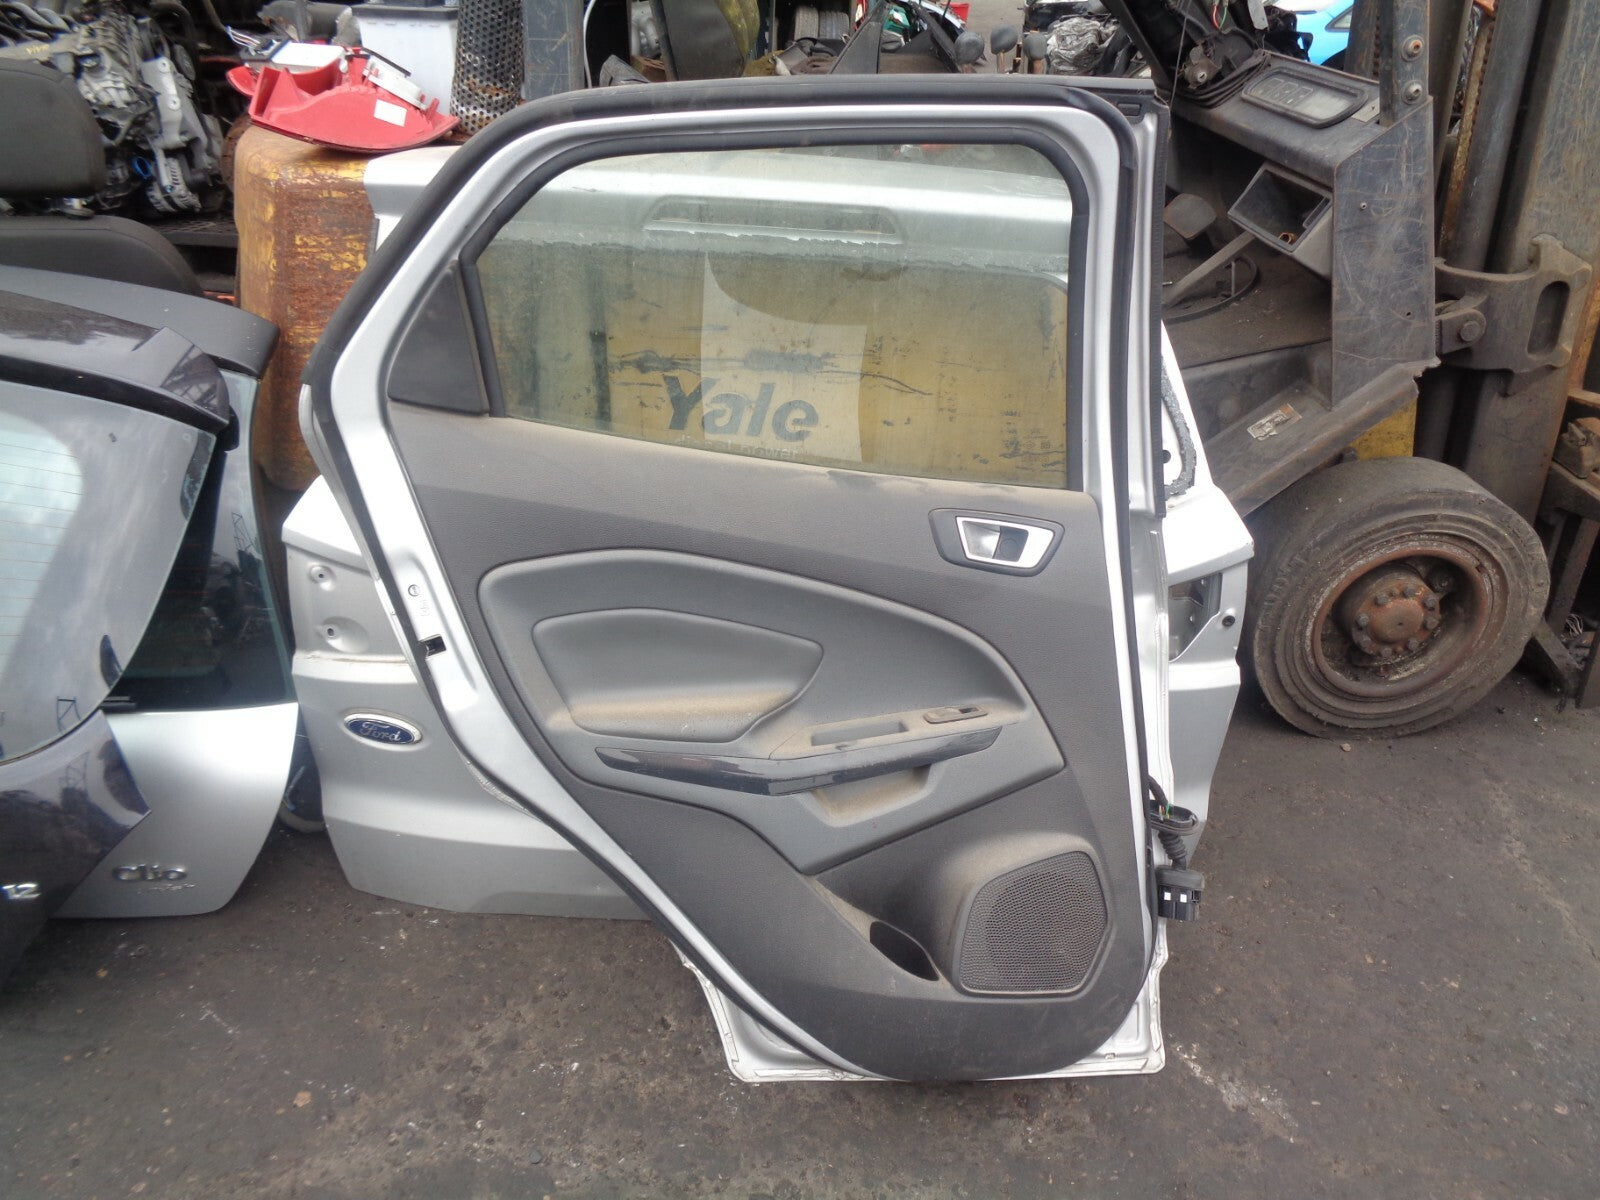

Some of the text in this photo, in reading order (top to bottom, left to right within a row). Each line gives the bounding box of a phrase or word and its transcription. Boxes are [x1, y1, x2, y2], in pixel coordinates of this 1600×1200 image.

[663, 375, 819, 442] Yale
[360, 721, 402, 741] Ford
[112, 864, 187, 881] Clio
